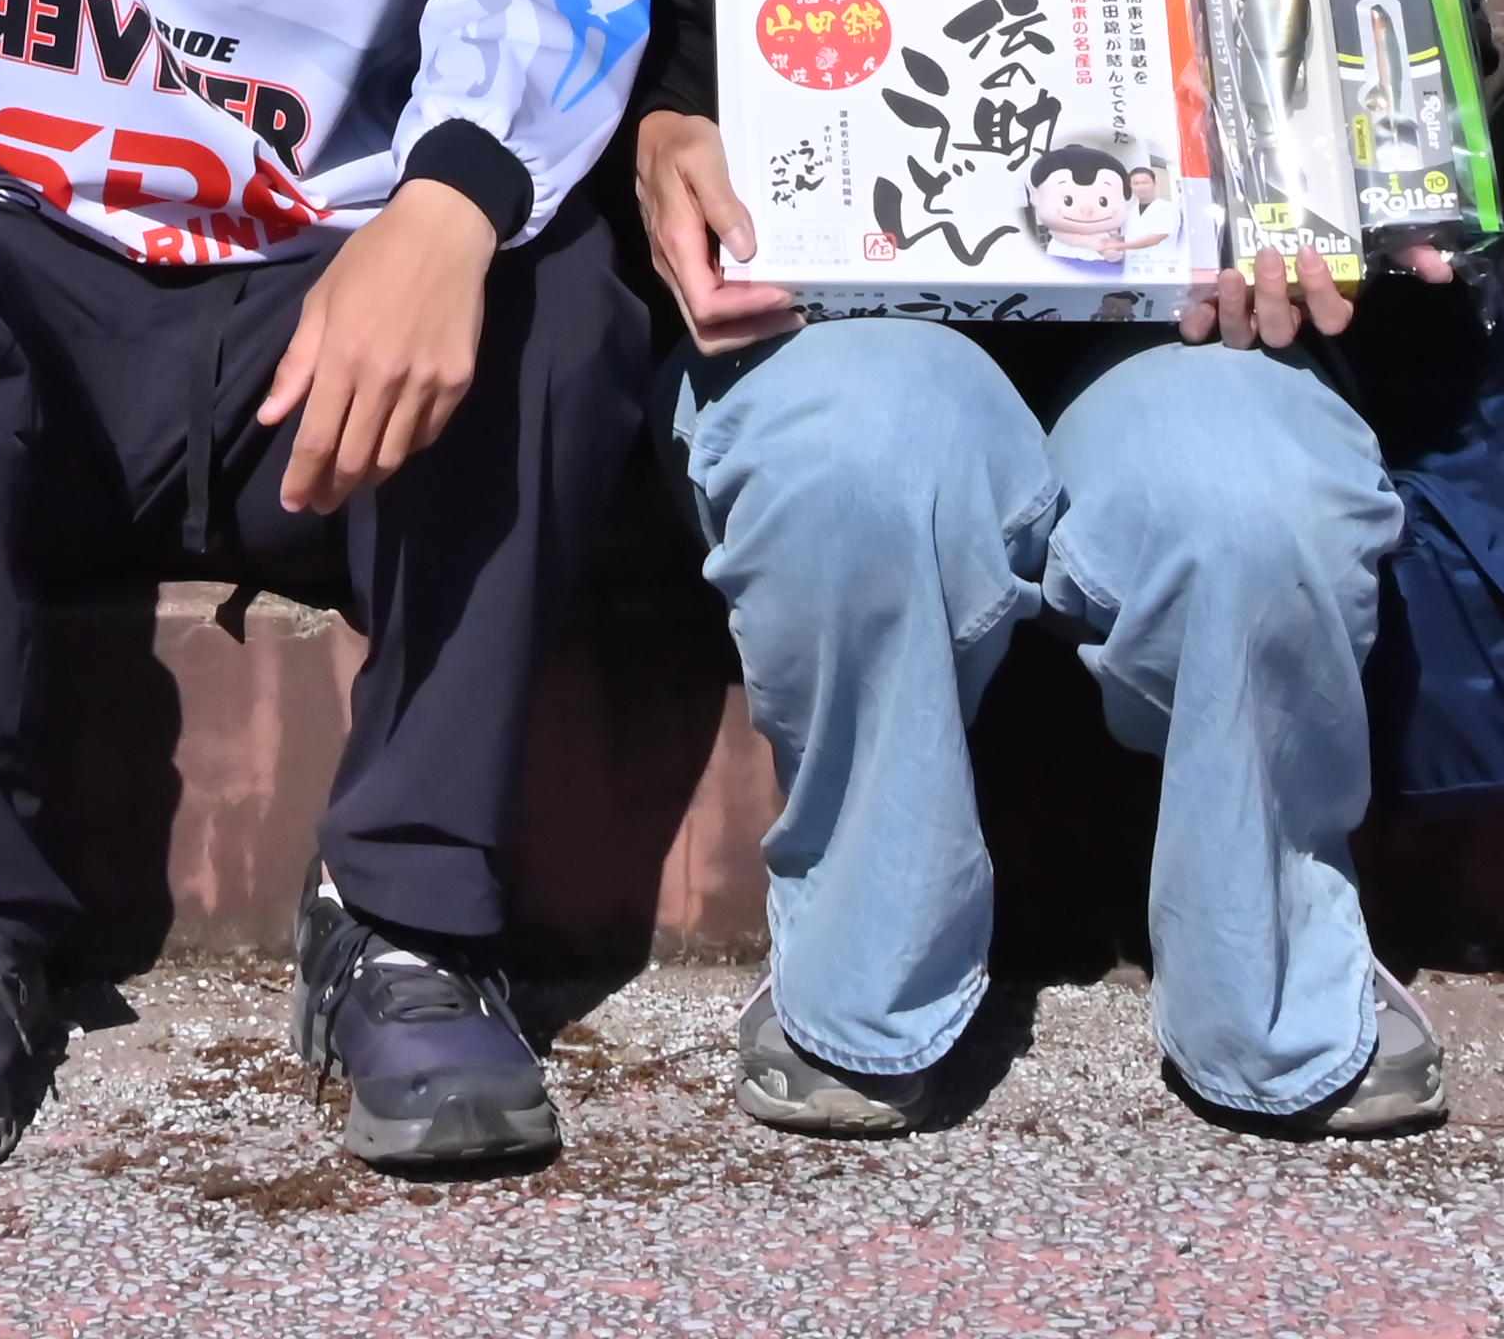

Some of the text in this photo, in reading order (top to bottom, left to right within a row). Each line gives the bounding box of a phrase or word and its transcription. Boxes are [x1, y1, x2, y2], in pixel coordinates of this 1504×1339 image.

[875, 48, 1021, 266] うどん
[1359, 187, 1458, 217] Roller
